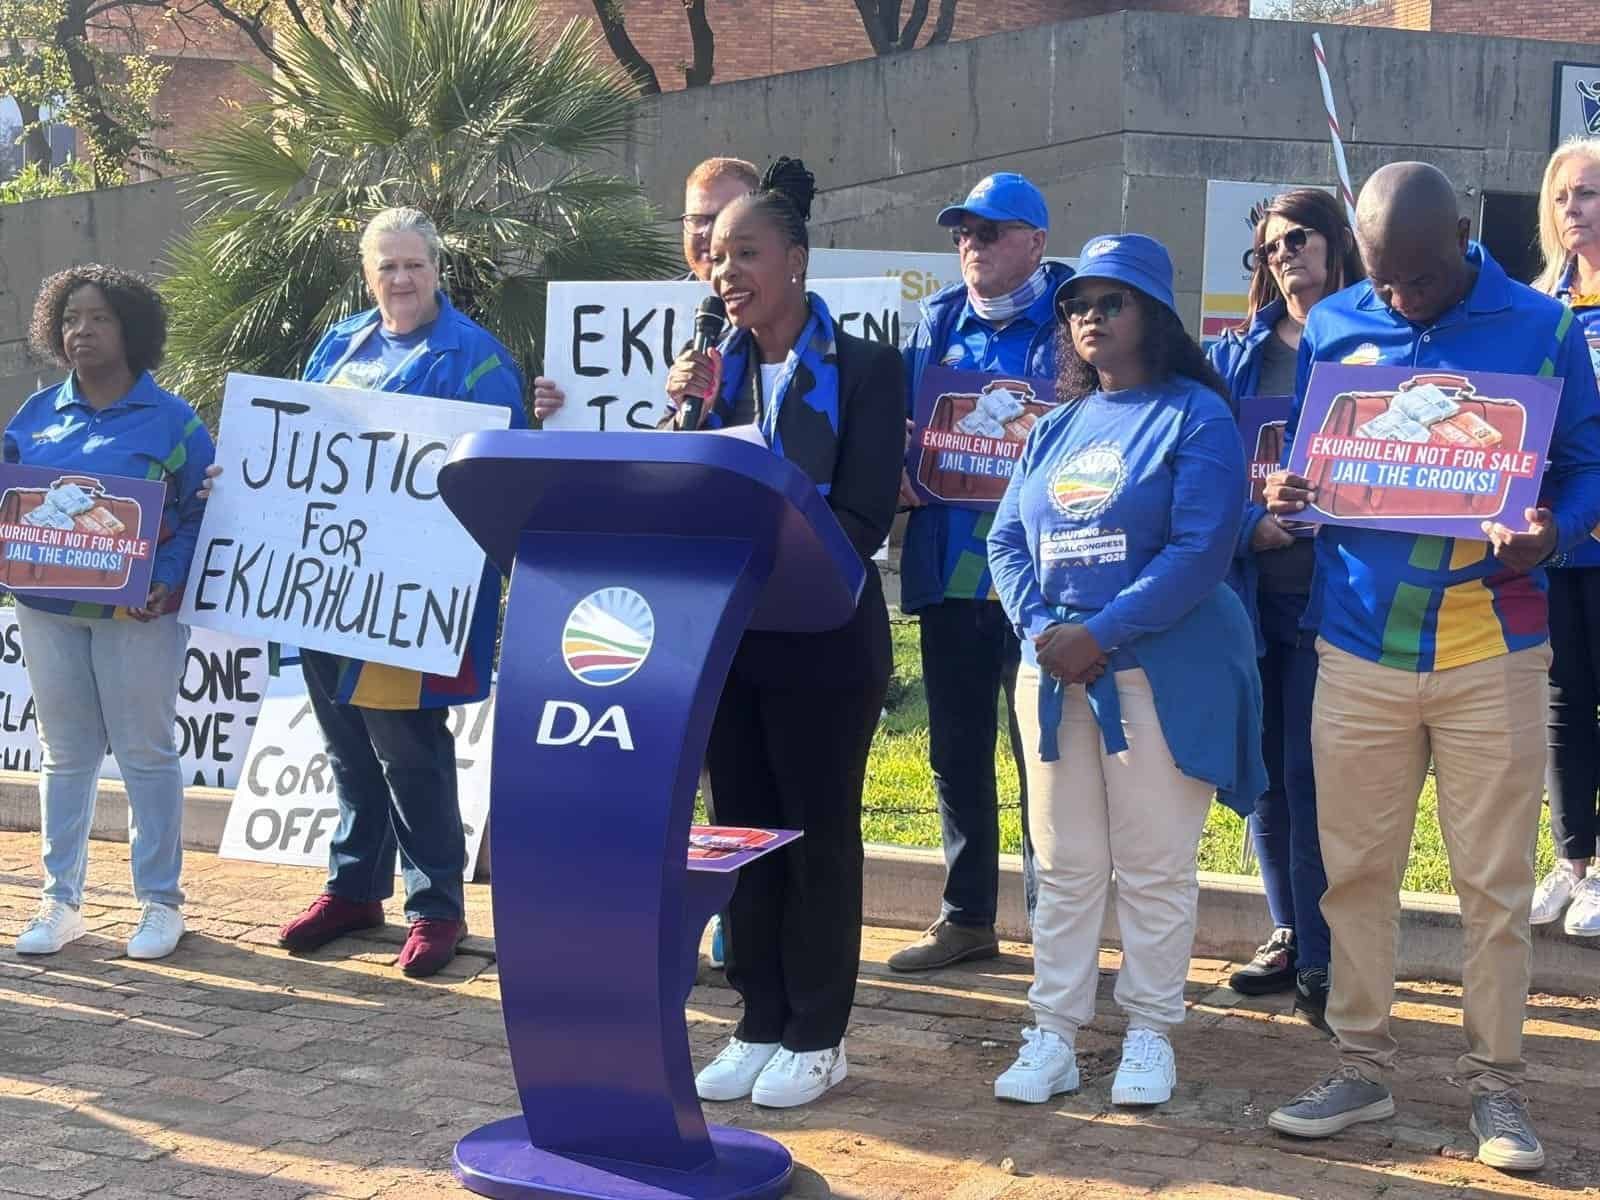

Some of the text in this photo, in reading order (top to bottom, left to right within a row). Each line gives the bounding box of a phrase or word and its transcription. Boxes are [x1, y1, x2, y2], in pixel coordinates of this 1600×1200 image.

[242, 398, 449, 500] JUSTIC
[923, 431, 1019, 458] EKURHULENI NOT
[1312, 437, 1533, 474] EKURHULENI NOT FOR SALE
[939, 453, 964, 471] JAIL
[969, 456, 993, 474] THE
[1333, 462, 1496, 493] JAIL THE CROOKS!
[0, 523, 147, 556] KURHULENI NOT FOR SALE
[302, 502, 368, 567] FOR
[1076, 540, 1124, 552] CONGRESS
[6, 543, 122, 569] JAIL THE CROOKS!
[195, 538, 471, 656] EKURHULENI
[536, 700, 635, 750] DA
